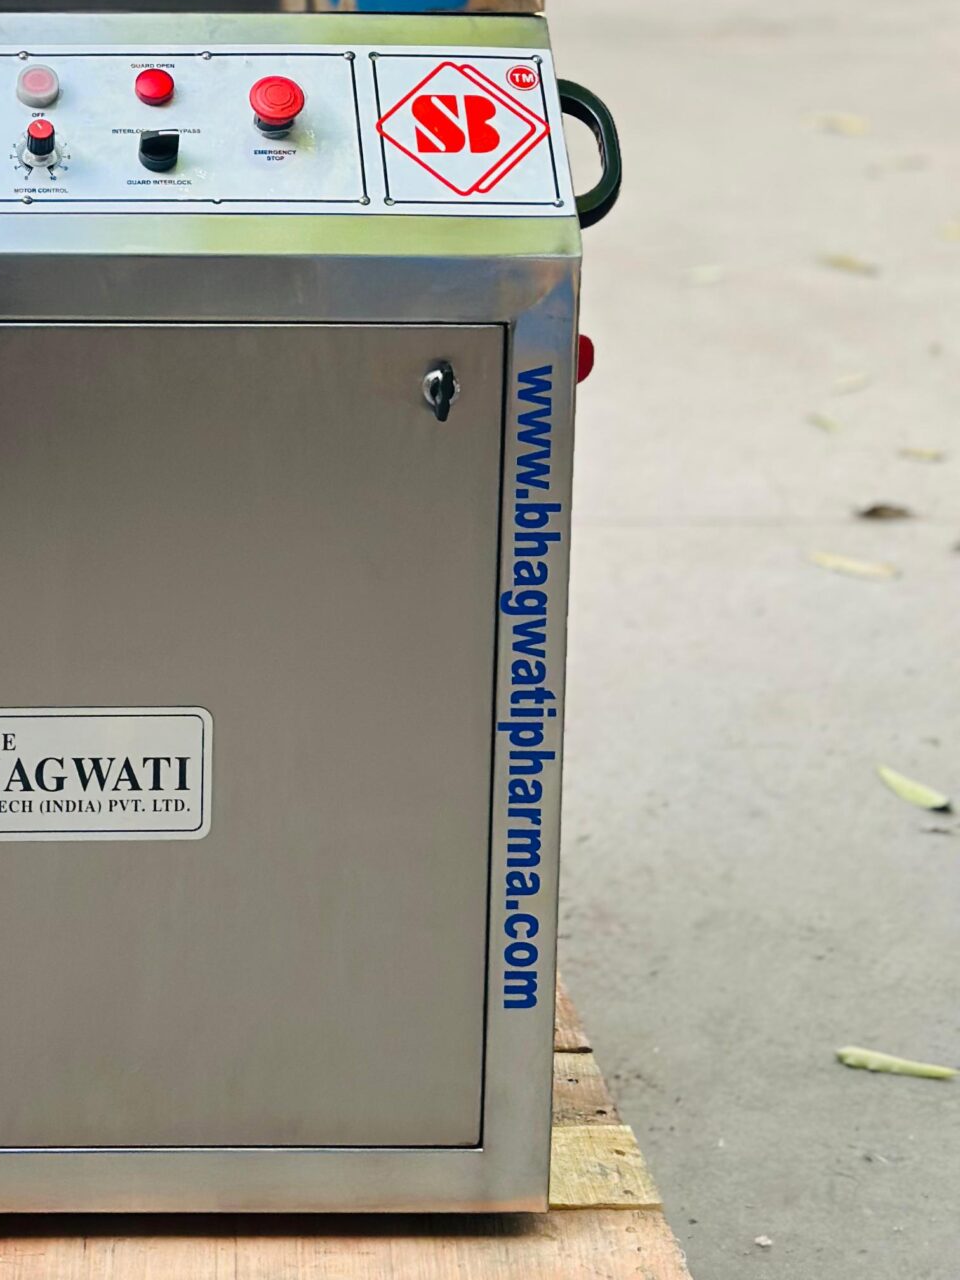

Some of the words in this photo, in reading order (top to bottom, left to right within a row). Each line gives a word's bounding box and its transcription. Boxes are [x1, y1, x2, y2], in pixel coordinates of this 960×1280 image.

[512, 73, 535, 83] TM
[411, 95, 500, 153] SB
[497, 365, 561, 1010] www.bhagwatipharma.com
[39, 799, 102, 814] (INDIA)
[108, 799, 145, 812] PVT.
[153, 799, 191, 812] LTD.
